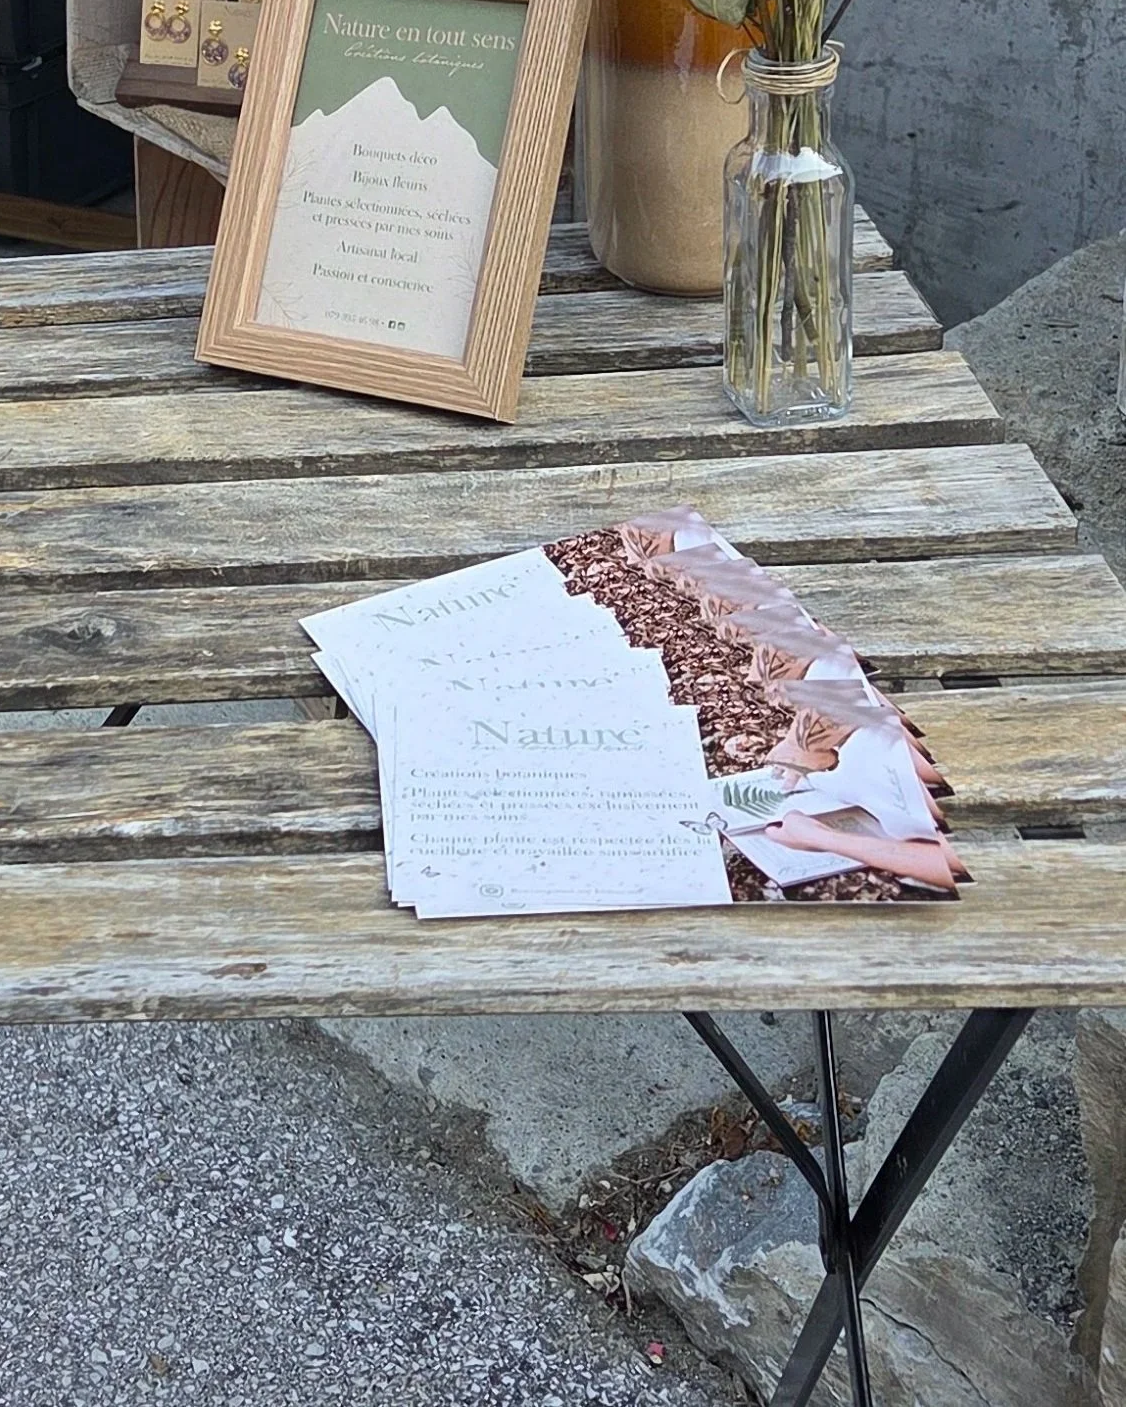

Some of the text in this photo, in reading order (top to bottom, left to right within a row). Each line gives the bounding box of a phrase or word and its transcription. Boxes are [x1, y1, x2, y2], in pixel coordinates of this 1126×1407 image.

[323, 12, 516, 52] Nature en tout sens
[353, 143, 438, 166] Bouquets déco
[353, 170, 428, 192] Bijoux fleuris
[303, 190, 342, 207] Plantes
[426, 209, 471, 225] séchées
[312, 213, 454, 241] et pressées par mes soins
[336, 240, 419, 264] Artisanat local
[312, 263, 434, 293] Passion et conscience
[373, 581, 517, 632] Nature
[472, 719, 642, 746] Nature
[410, 768, 587, 781] Créations botaniques
[410, 787, 470, 798] Plantes
[577, 800, 700, 811] exclusivement
[410, 813, 435, 823] par
[410, 833, 473, 845] Chaque
